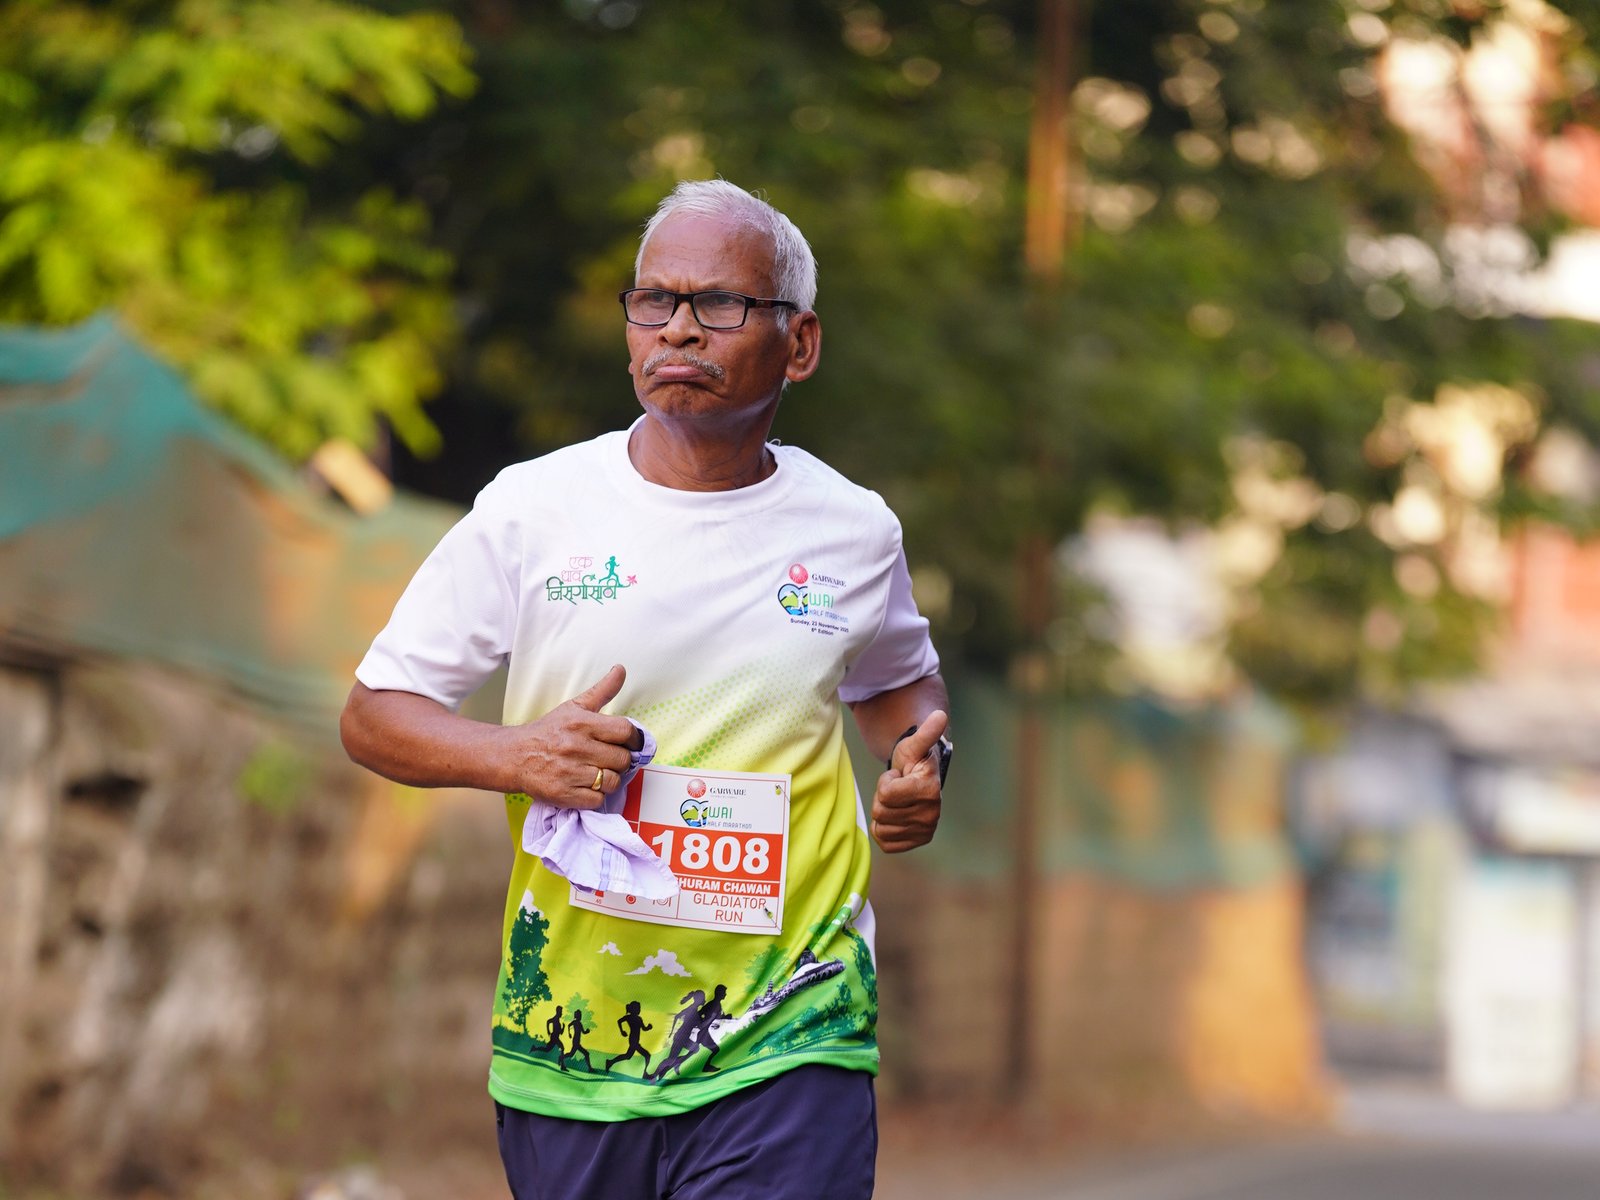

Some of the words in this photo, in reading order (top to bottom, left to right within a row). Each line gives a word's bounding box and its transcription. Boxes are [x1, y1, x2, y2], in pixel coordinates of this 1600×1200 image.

[569, 556, 594, 569] एक
[809, 592, 834, 608] WAI
[710, 787, 747, 796] GARWARE
[708, 806, 733, 819] WAI
[651, 829, 770, 875] 1808
[723, 882, 771, 895] CHAWAN
[693, 892, 767, 909] GLADIATOR
[715, 909, 743, 924] RUN
